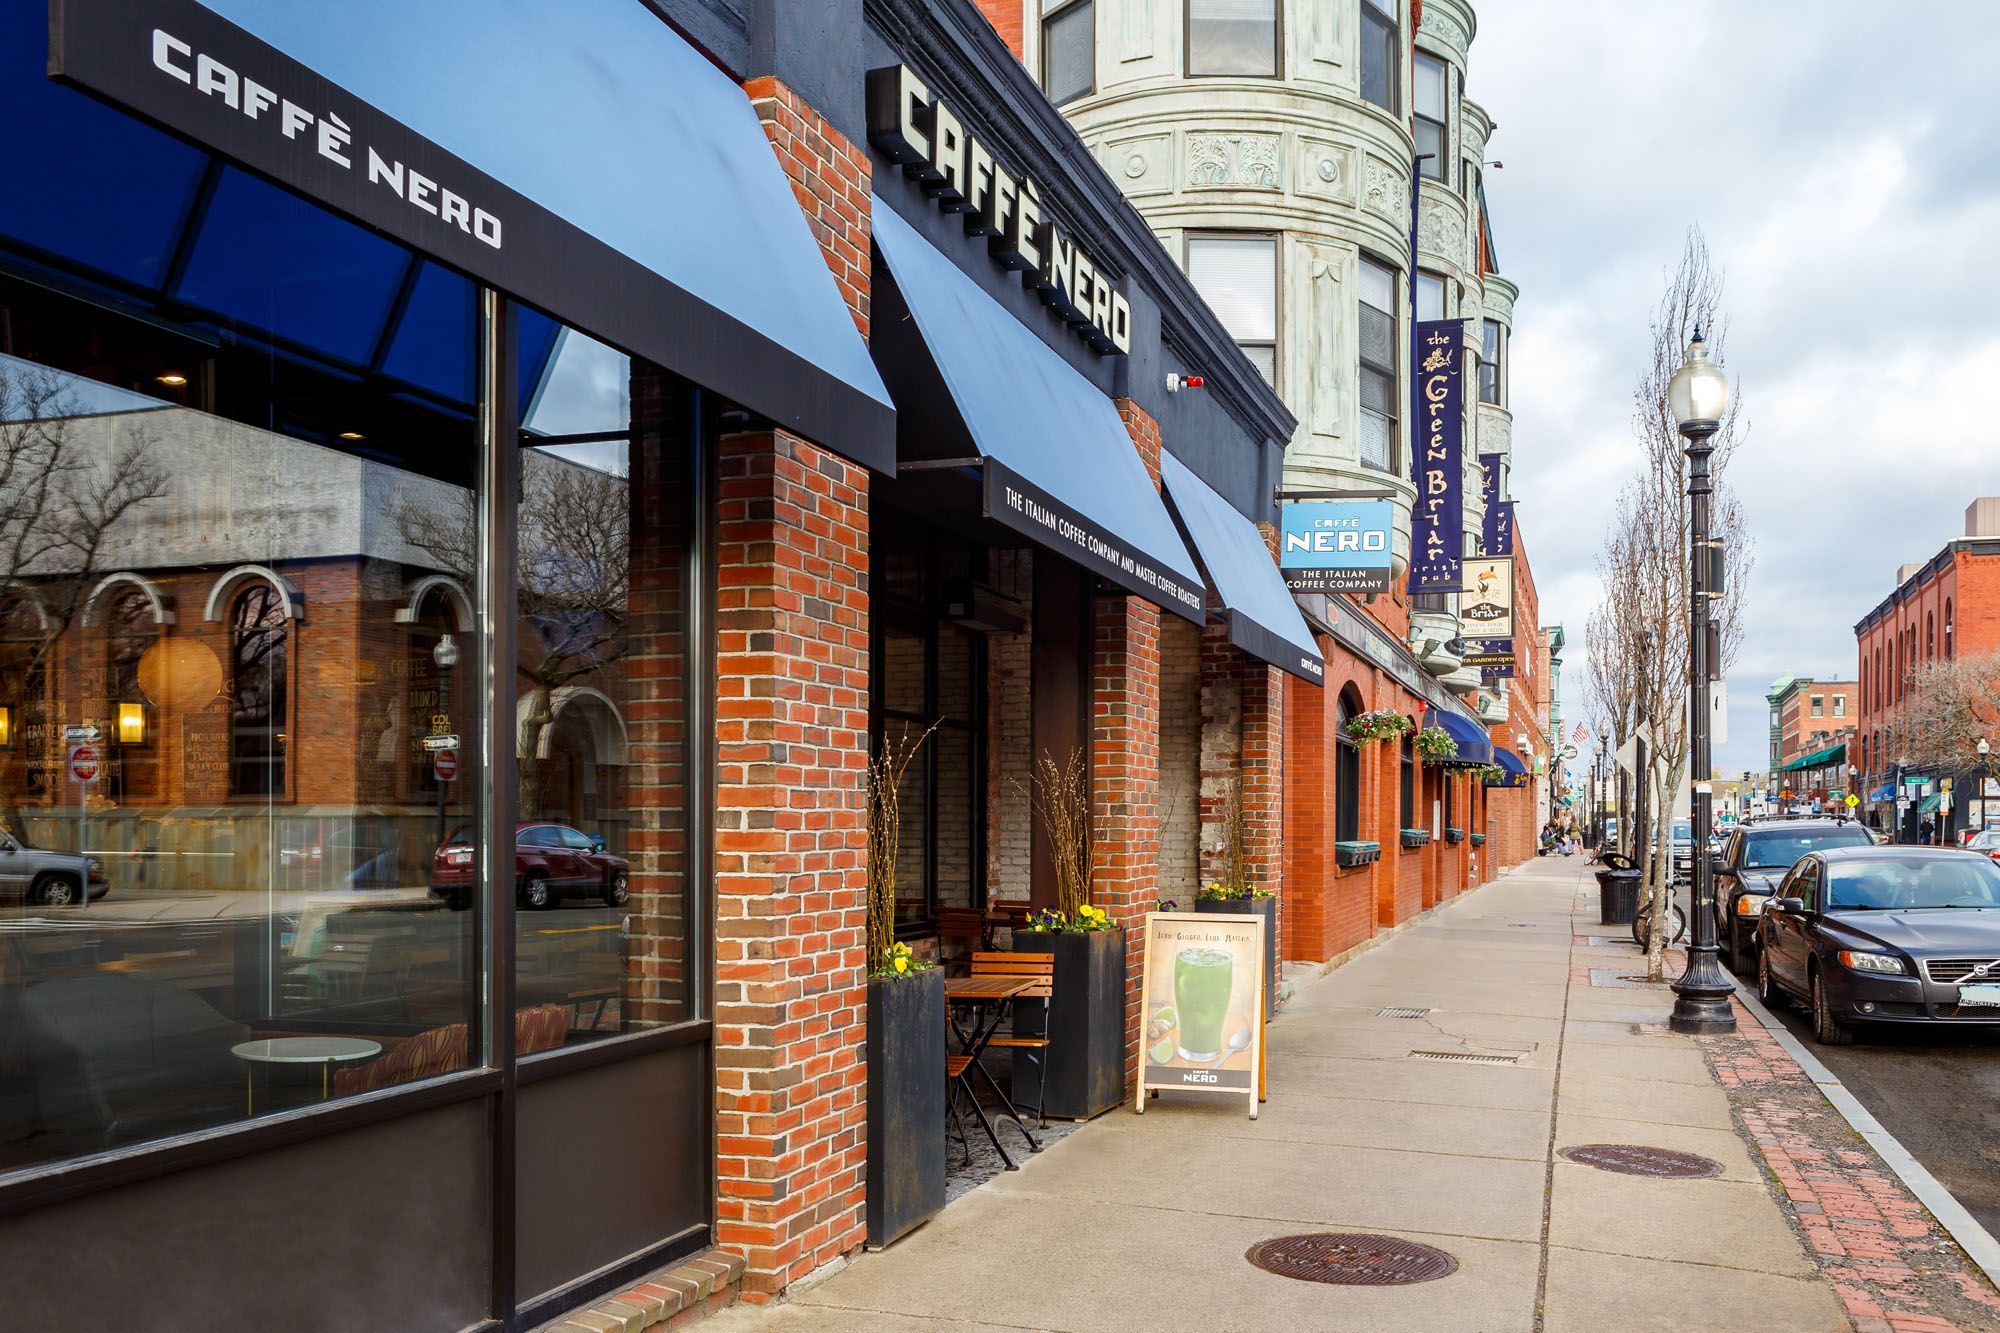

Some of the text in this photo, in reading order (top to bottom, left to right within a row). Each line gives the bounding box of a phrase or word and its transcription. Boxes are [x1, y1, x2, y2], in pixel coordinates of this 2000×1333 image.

[152, 28, 502, 250] CAFFÈ NERO
[900, 63, 1132, 356] CAFFÈ NERO
[1426, 330, 1450, 345] the
[1005, 486, 1200, 611] THE ITALIAN COFFEE COMPANY AND MASTER COFFEE ROASTERS
[1286, 530, 1386, 553] NERO
[1302, 570, 1367, 579] THE ITALIAN
[1421, 571, 1451, 585] pub
[1286, 580, 1383, 589] COFFEE COMPANY
[1480, 602, 1491, 610] the
[1183, 1073, 1218, 1083] NERO
